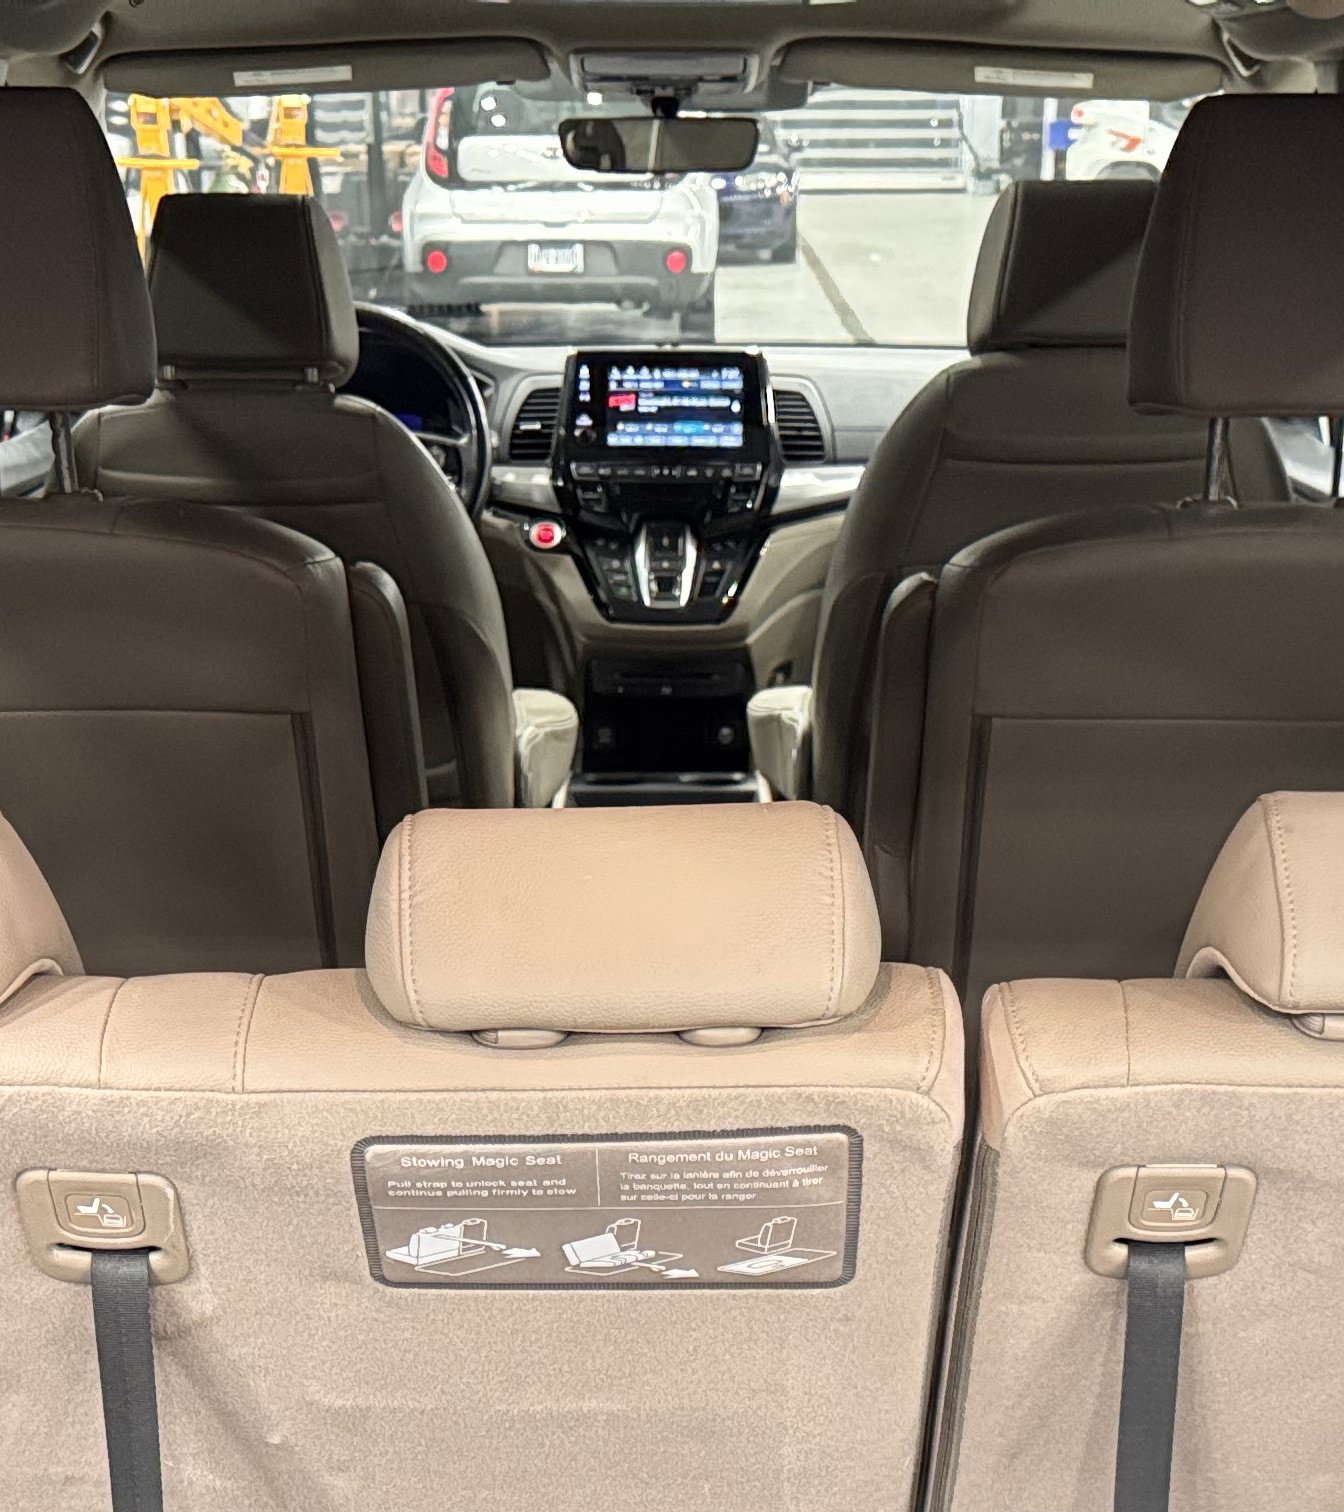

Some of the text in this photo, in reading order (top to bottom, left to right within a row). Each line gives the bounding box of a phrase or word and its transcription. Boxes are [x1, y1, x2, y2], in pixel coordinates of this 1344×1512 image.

[400, 1154, 563, 1169] Stowing Magic Seat
[628, 1145, 818, 1166] Rangement du Magic Seat
[619, 1171, 647, 1180] Tirez
[649, 1172, 668, 1180] sur
[670, 1171, 681, 1180] la
[682, 1169, 720, 1179] lanière
[722, 1169, 743, 1179] afin
[745, 1169, 760, 1178] de
[387, 1178, 567, 1189] Pull strap to unlock seat and
[619, 1183, 631, 1191] la
[693, 1182, 715, 1190] tout
[716, 1182, 731, 1190] en
[733, 1180, 790, 1190] continuant
[801, 1176, 824, 1187] tirer
[387, 1186, 577, 1198] continue pulling firmly to stow
[640, 1193, 679, 1201] celle-ci
[681, 1193, 707, 1202] pour
[708, 1192, 719, 1201] la
[721, 1193, 757, 1202] ranger
